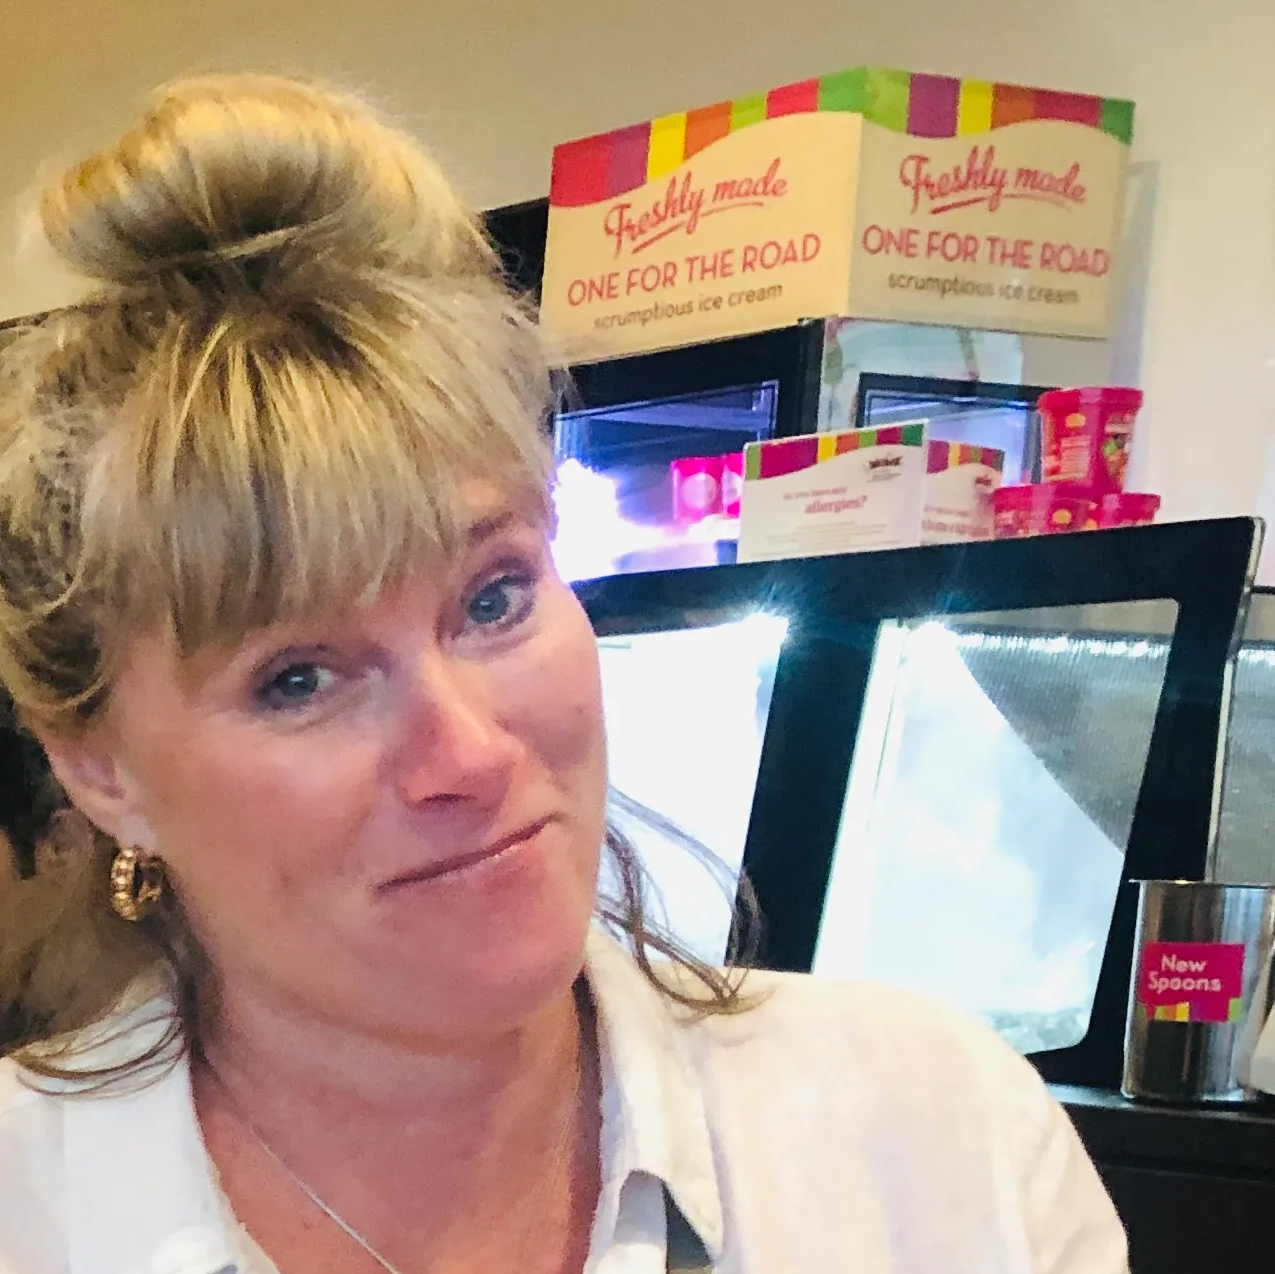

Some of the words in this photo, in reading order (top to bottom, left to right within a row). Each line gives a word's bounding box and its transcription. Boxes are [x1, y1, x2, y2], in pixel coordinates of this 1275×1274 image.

[900, 145, 1007, 214] Freshly
[1014, 163, 1086, 203] made
[604, 171, 703, 258] Freshly
[712, 157, 788, 200] made
[567, 272, 620, 306] ONE
[626, 262, 678, 295] FOR
[685, 248, 735, 284] THE
[742, 233, 821, 273] ROAD
[862, 225, 920, 258] ONE
[927, 231, 980, 263] FOR
[986, 236, 1034, 269] THE
[1040, 242, 1111, 277] ROAD
[594, 298, 694, 330] scrumptious
[698, 292, 724, 313] ice
[728, 284, 783, 307] cream
[888, 274, 996, 299] scrumptious
[999, 282, 1024, 300] ice
[1027, 287, 1080, 304] cream
[1148, 971, 1222, 995] Spoons
[1161, 953, 1208, 973] New
